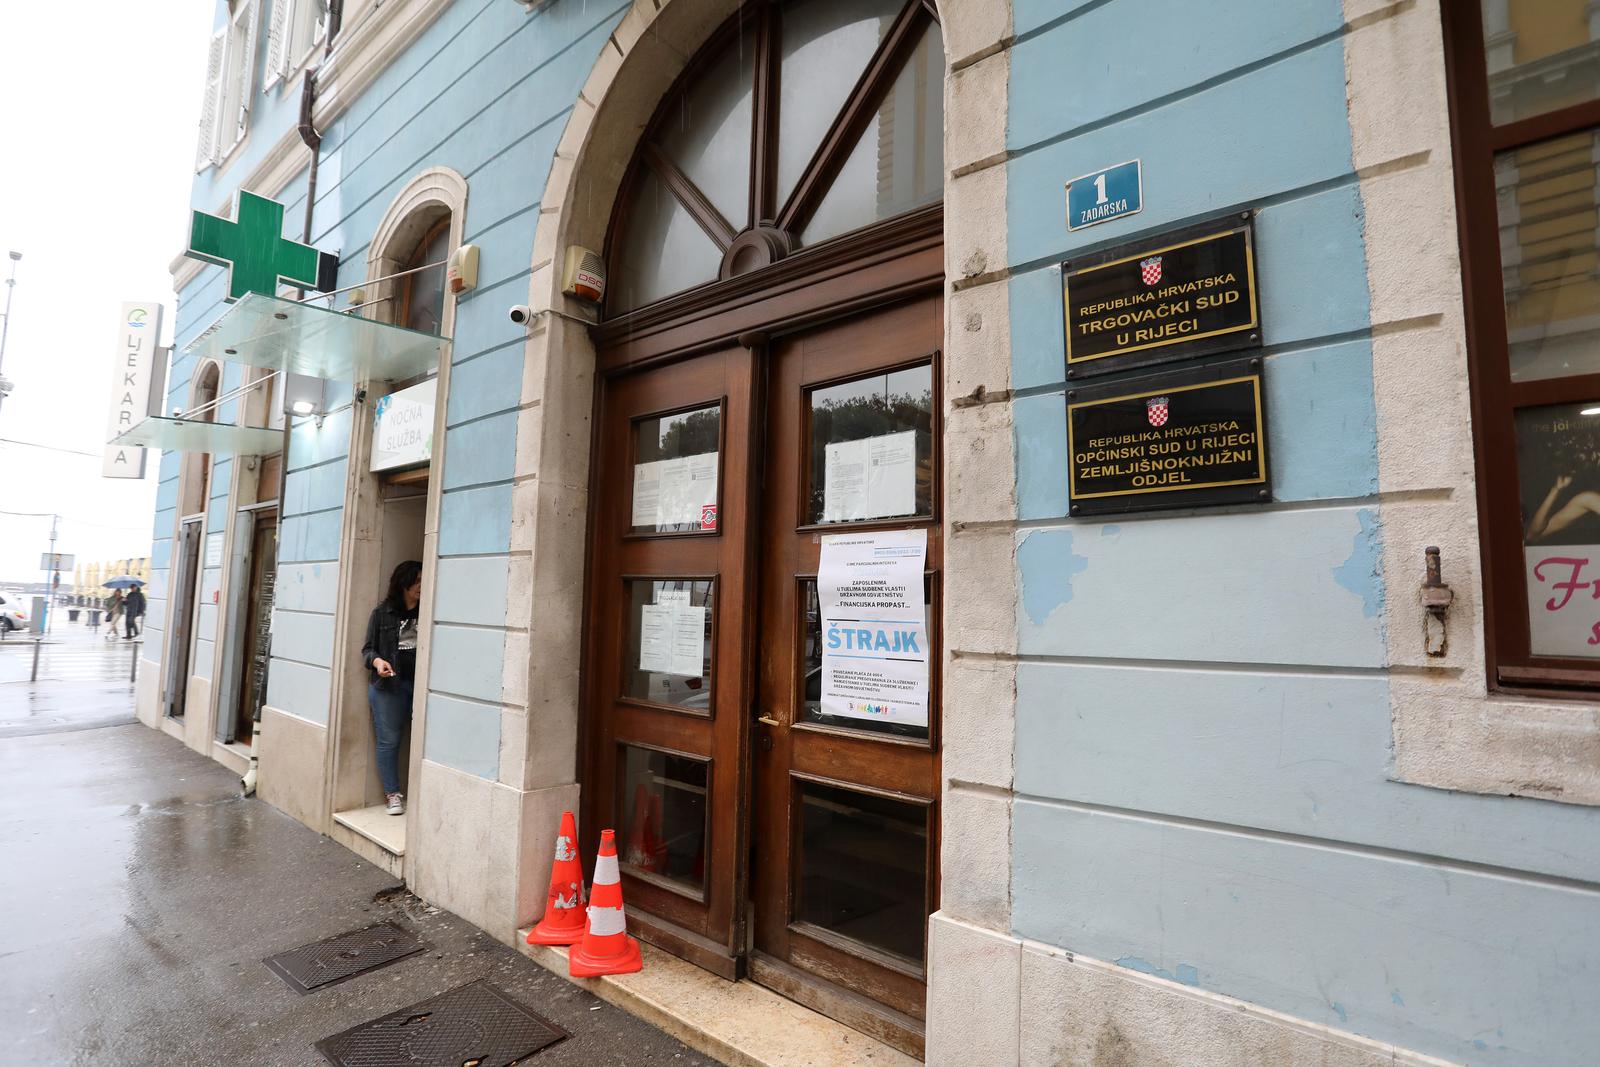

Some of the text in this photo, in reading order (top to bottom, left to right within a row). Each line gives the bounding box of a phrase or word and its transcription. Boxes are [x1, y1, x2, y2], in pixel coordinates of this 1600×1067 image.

[1093, 173, 1109, 206] 1
[1080, 198, 1128, 224] ZADARSKA
[578, 273, 603, 289] DSC
[1080, 272, 1236, 317] REPUBLIKA HRVATSKA
[1079, 289, 1240, 336] TRGOVAČKI SUD
[1116, 317, 1199, 346] U RIJECI
[390, 404, 424, 426] NOČNA
[386, 429, 422, 450] SLUŽBA
[1075, 431, 1255, 465] OPĆINSKI SUD U RIJECI
[1088, 420, 1239, 448] REPUBLIKA HRVATSKA
[1080, 449, 1252, 480] ZEMLJIŠNOKNJIŽNI
[1131, 471, 1192, 487] ODJEL
[827, 623, 920, 654] ŠTRAJK
